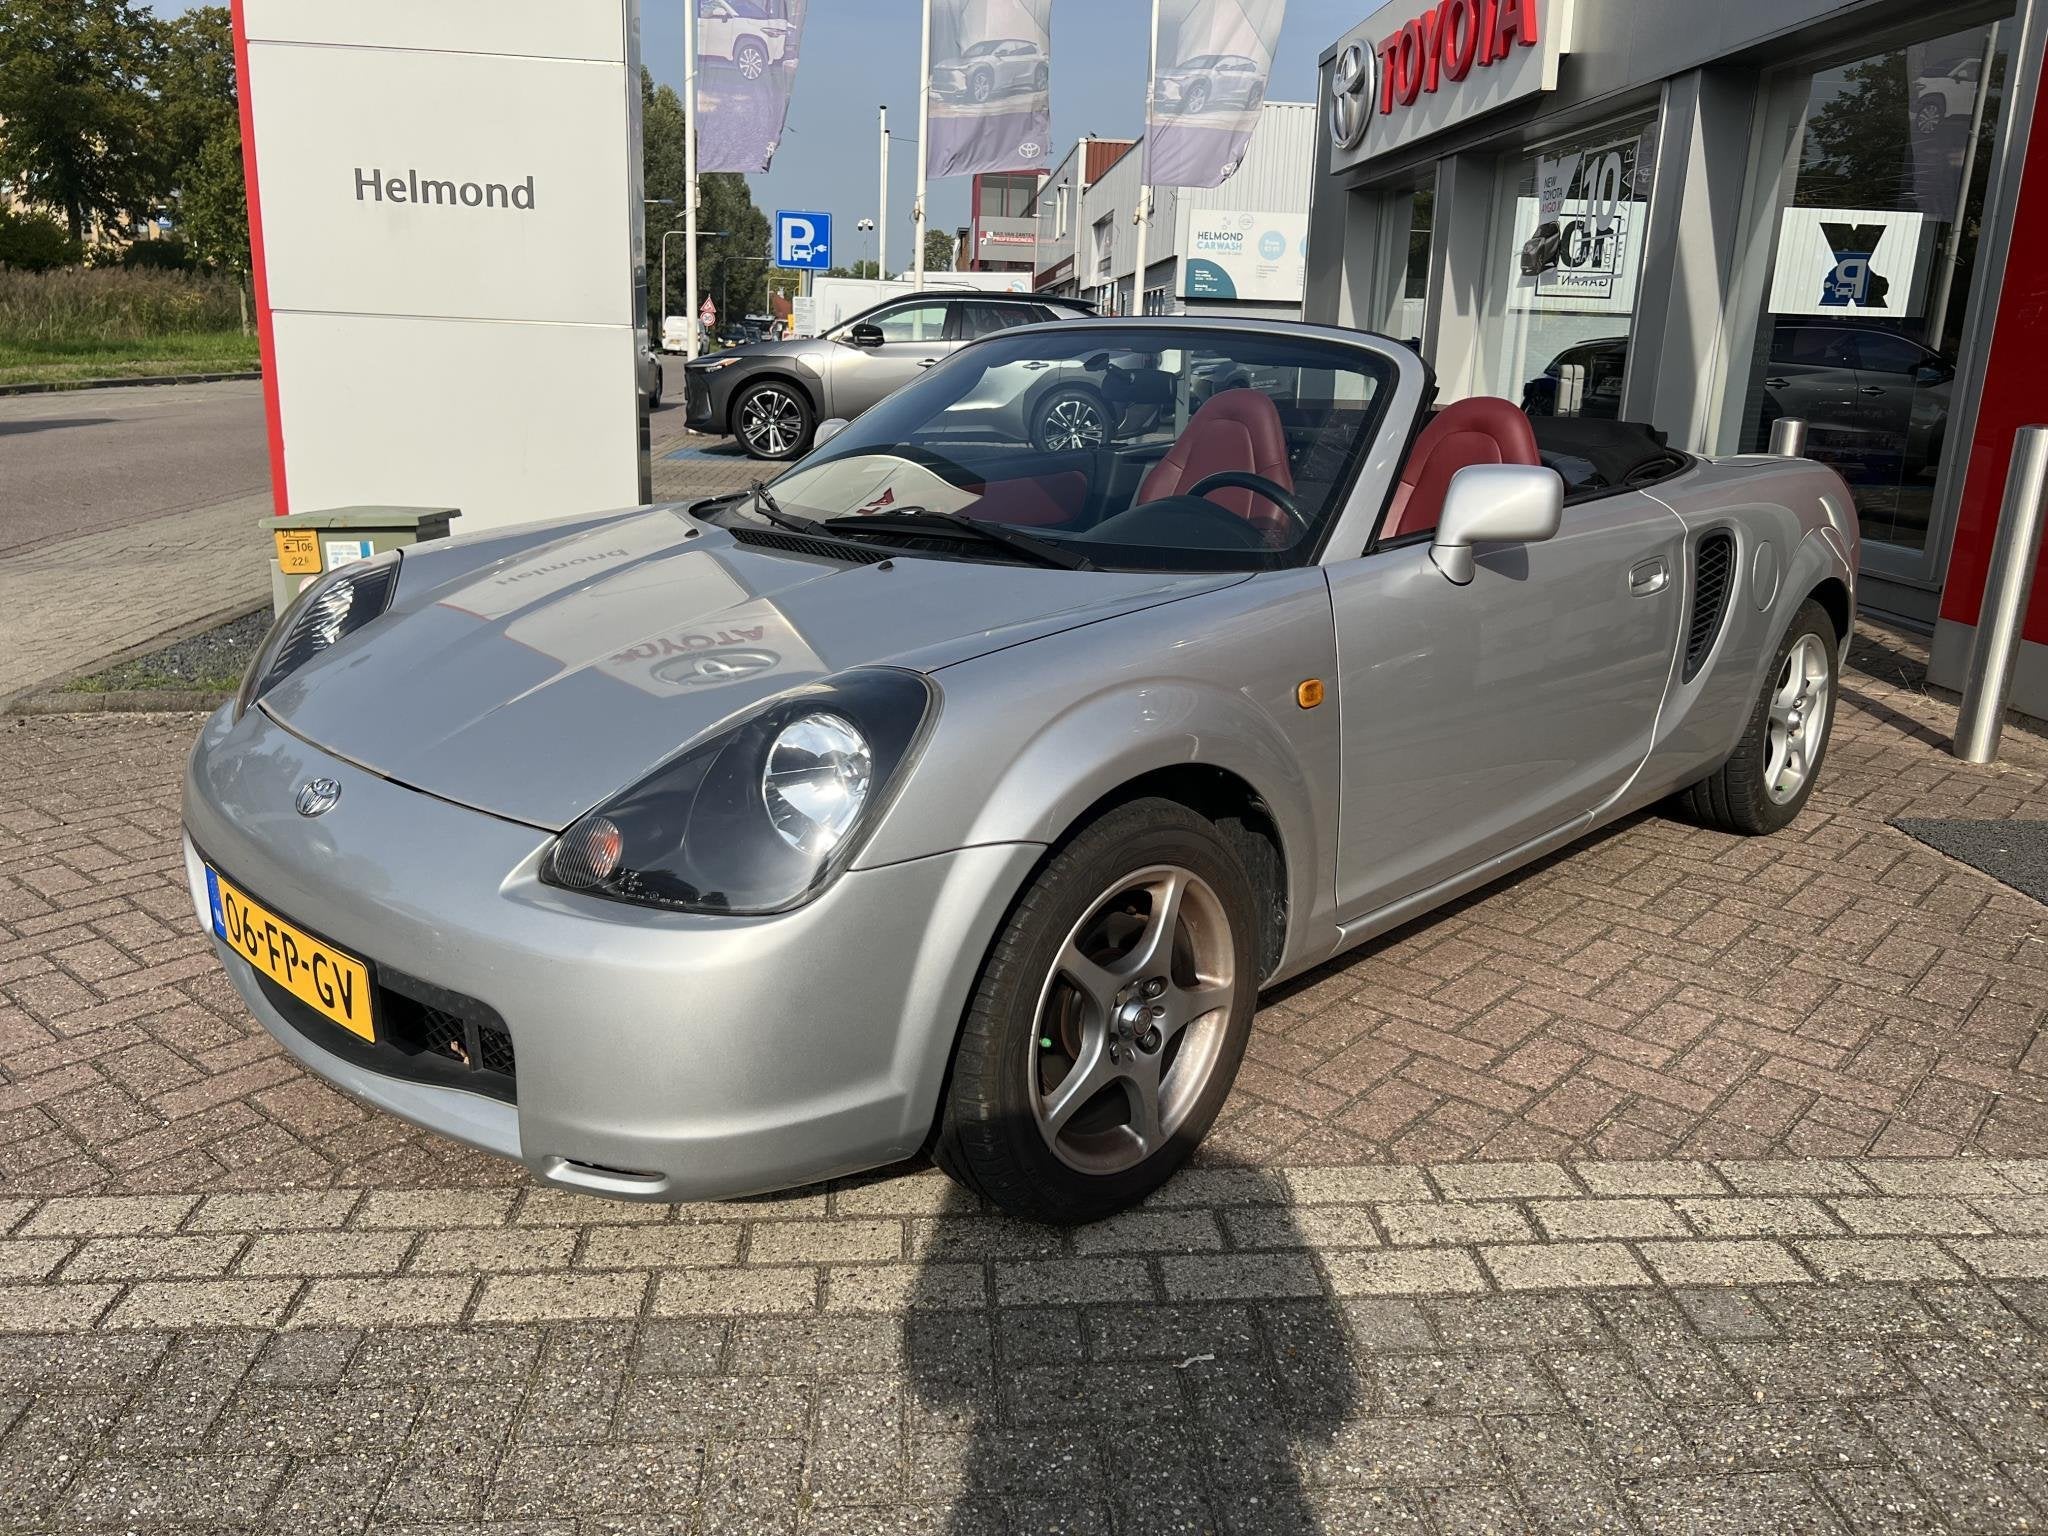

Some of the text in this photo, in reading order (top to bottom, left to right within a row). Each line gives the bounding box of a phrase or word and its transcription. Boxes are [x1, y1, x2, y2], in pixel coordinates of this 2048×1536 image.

[354, 167, 535, 210] Helmond
[781, 217, 815, 261] P
[1196, 240, 1243, 250] CARWASH
[1197, 231, 1244, 241] HELMOND
[225, 892, 352, 1020] 06-FP-GV
